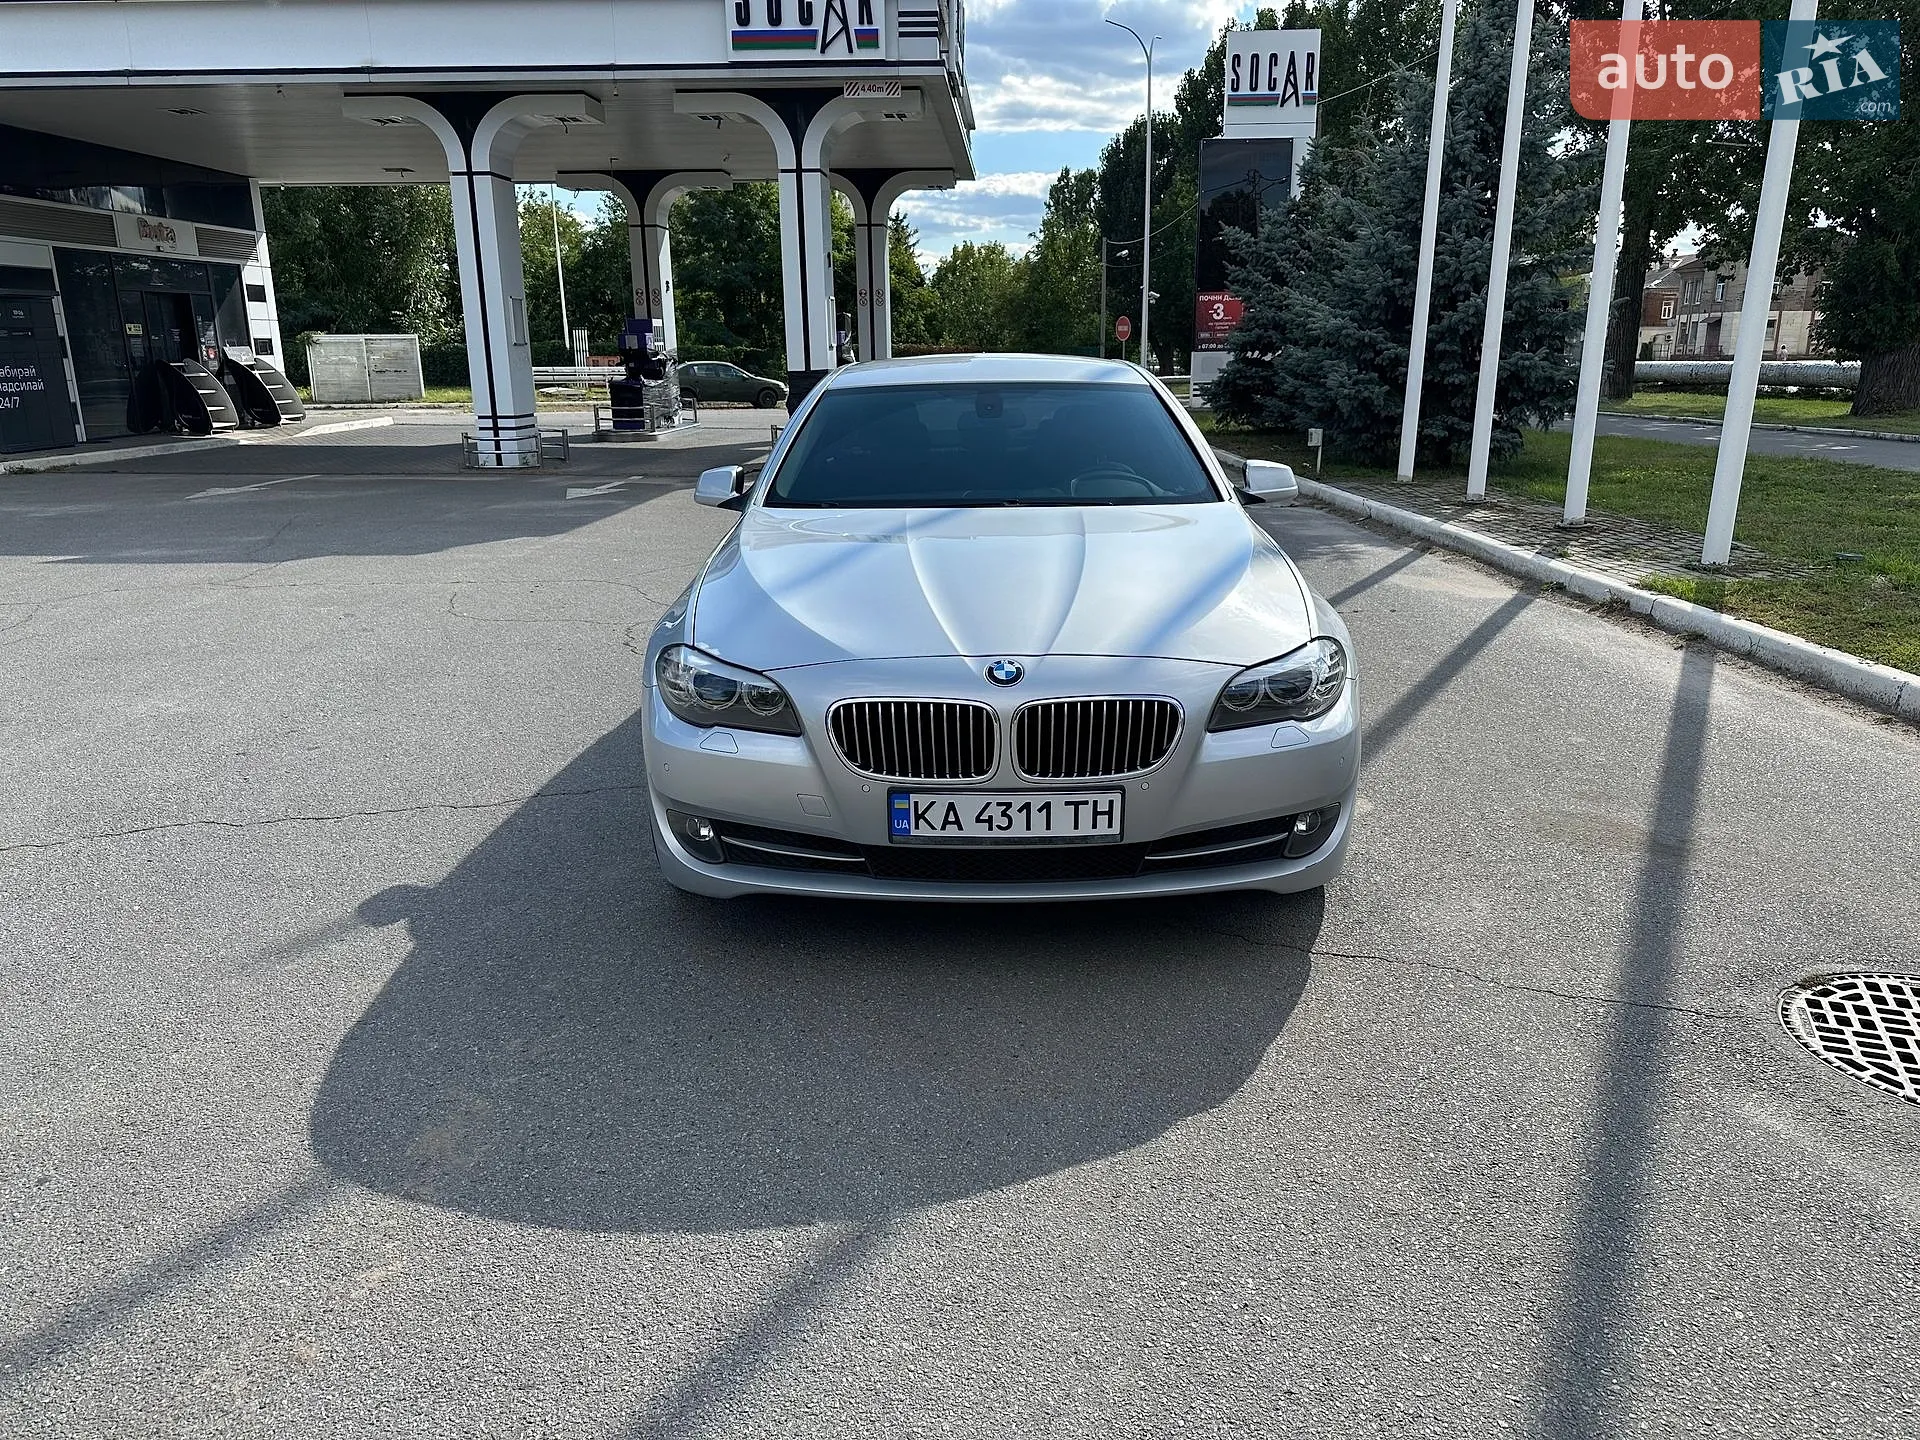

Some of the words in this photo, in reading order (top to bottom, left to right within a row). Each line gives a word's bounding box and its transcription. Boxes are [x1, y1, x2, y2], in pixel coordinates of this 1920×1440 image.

[1230, 51, 1315, 107] SOCAR
[861, 84, 884, 92] 4.40m
[0, 379, 44, 393] адсилай
[913, 800, 963, 831] KA
[974, 801, 1052, 831] 4311
[1064, 799, 1115, 830] TH
[894, 819, 909, 830] UA
